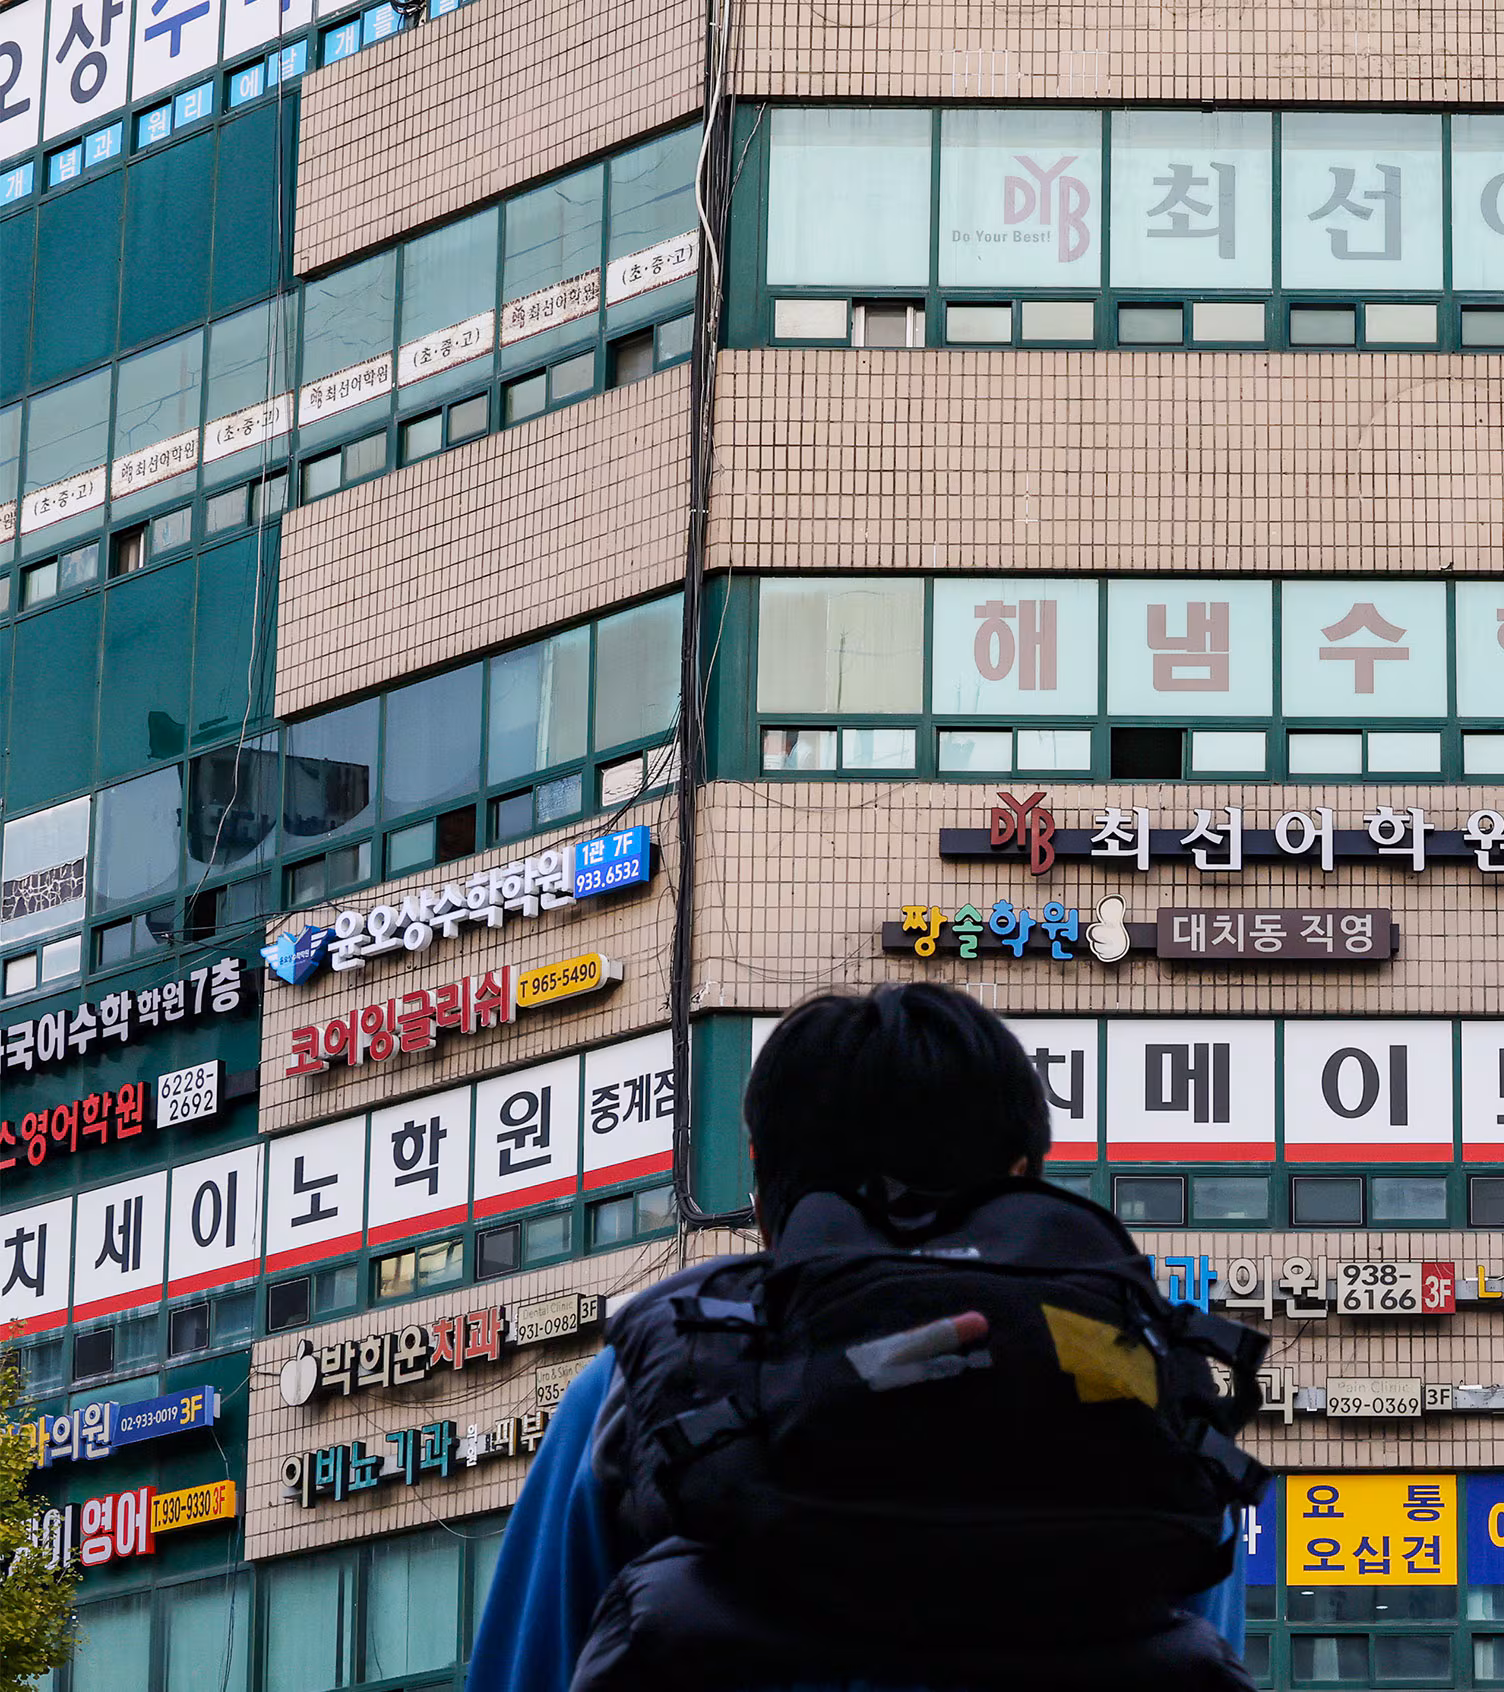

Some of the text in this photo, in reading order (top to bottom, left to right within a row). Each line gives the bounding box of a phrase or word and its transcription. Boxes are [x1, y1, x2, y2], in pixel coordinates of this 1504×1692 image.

[0, 0, 290, 122] 오상수
[1004, 156, 1090, 263] DYB
[952, 229, 1051, 242] Do Your Best!
[528, 282, 597, 322] 최선어학원
[325, 364, 389, 402] 최선어학원
[135, 440, 196, 475] 최선어학원
[582, 832, 633, 866] 1관 7F
[990, 791, 1055, 876] DYB
[577, 858, 639, 892] 933.6532
[328, 846, 576, 972] 윤오상수학학원
[901, 899, 1080, 961] 짱솔학원
[1172, 914, 1373, 954] 대치동 직영
[520, 961, 597, 998] T 965-5490
[0, 957, 241, 1071] 국어수학 학원 7층
[285, 965, 516, 1078] 코어잉글리쉬
[161, 1068, 214, 1099] 6228-
[169, 1089, 214, 1121] 2692
[2, 1085, 552, 1297] 치세이노학원
[1147, 1255, 1328, 1321] 과의원
[1343, 1265, 1411, 1287] 938-
[1343, 1275, 1451, 1311] 6166 3F
[519, 1300, 597, 1341] 931-0982 3F
[523, 1301, 573, 1320] Dental Clinic
[537, 1380, 571, 1402] 935-
[1329, 1389, 1450, 1413] 939-0369 3F
[5, 1394, 203, 1467] 과의원 02-933-0019 3F
[282, 1420, 452, 1509] 이비뇨기과
[212, 1485, 226, 1516] 3F
[1303, 1535, 1442, 1575] 오십견
